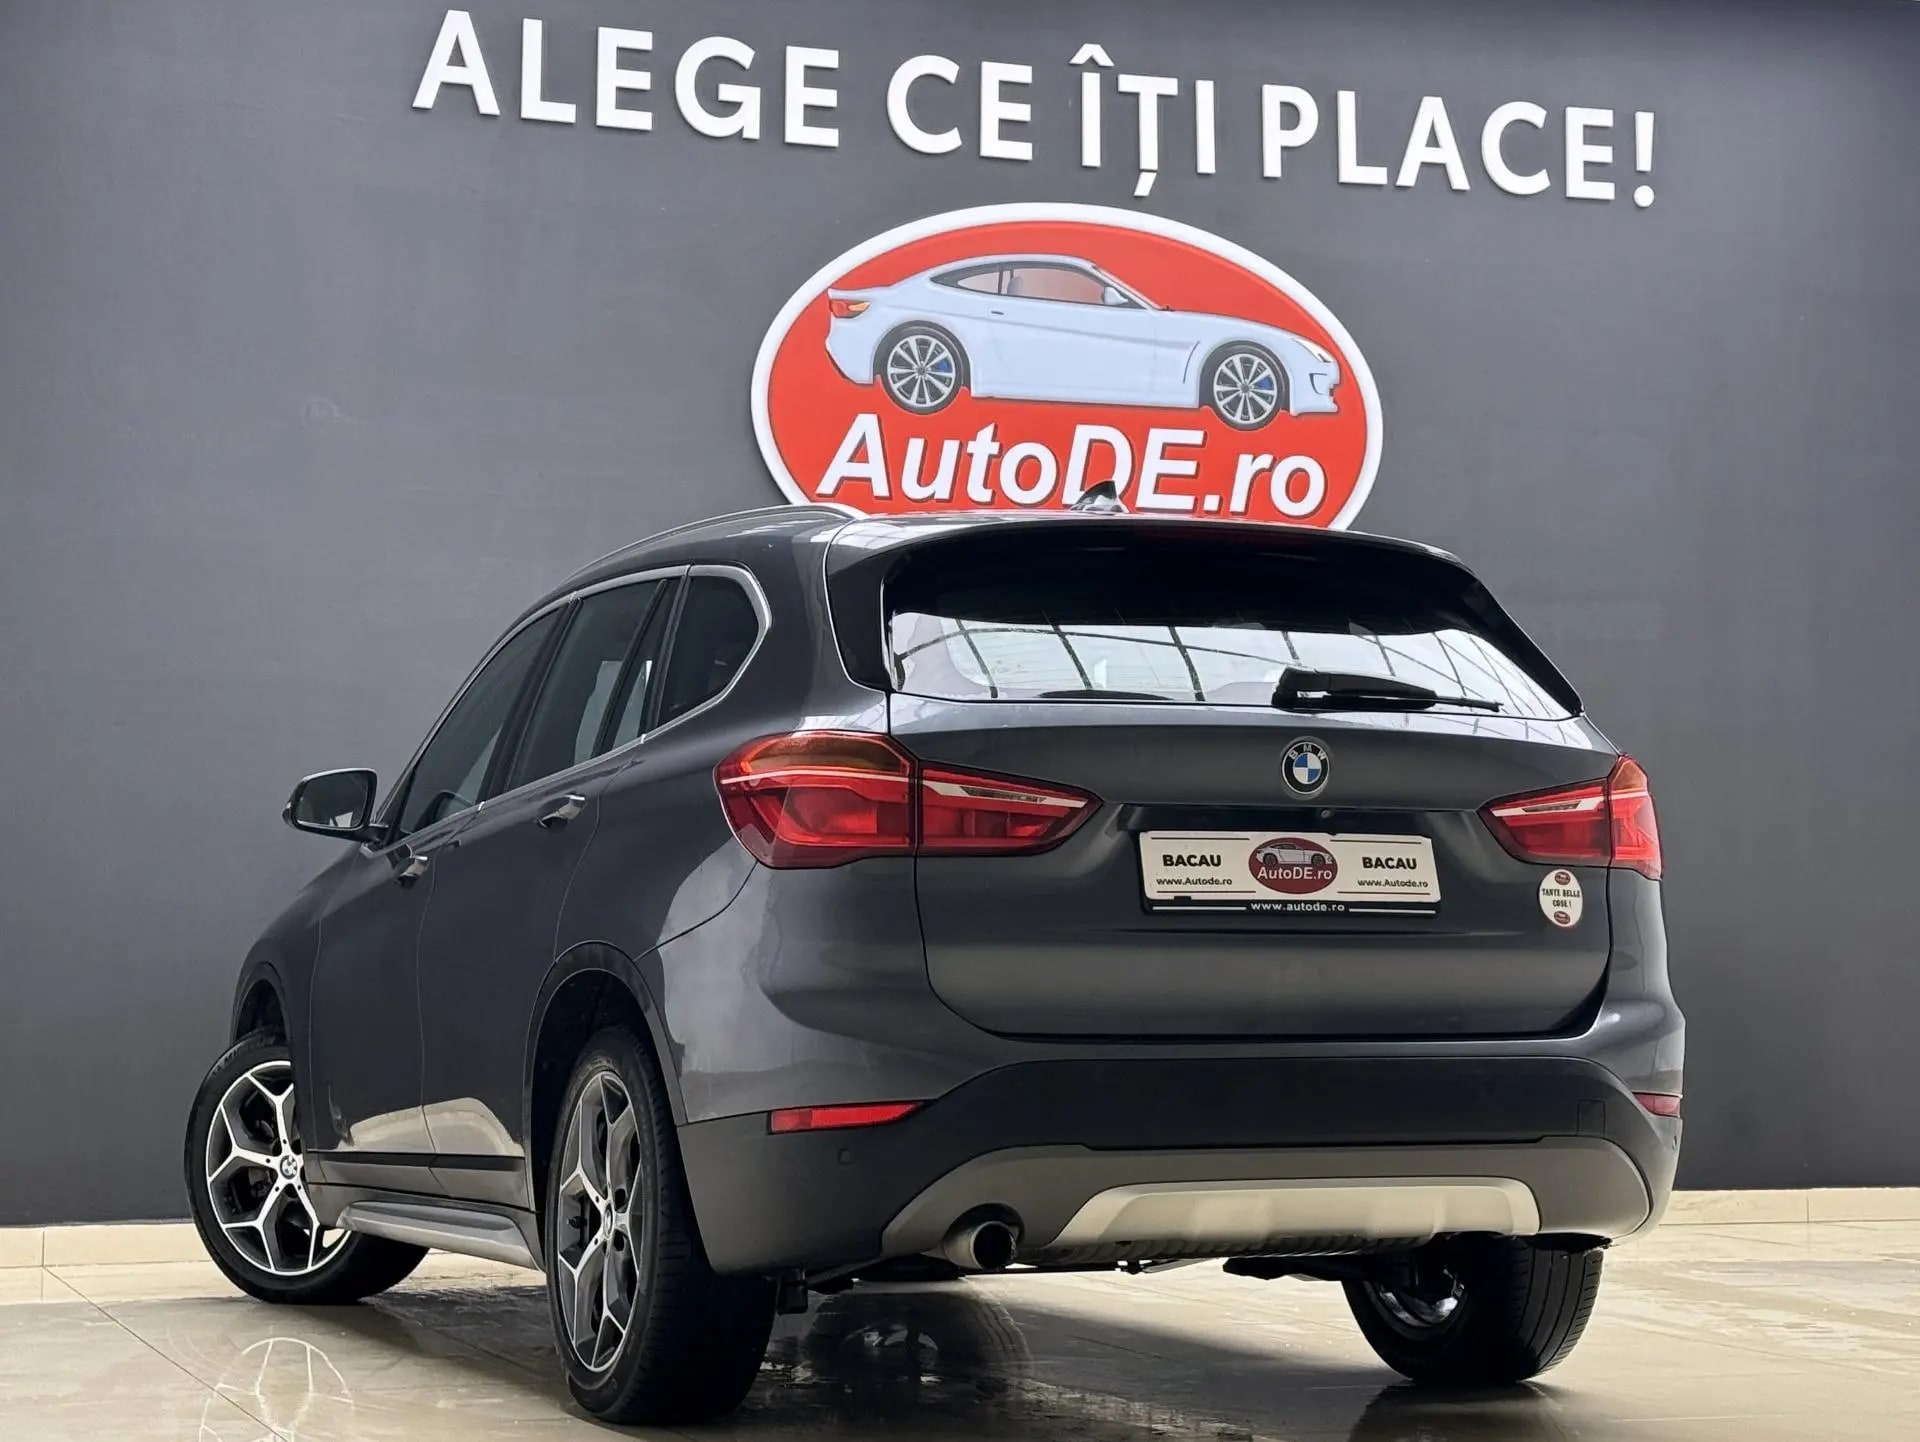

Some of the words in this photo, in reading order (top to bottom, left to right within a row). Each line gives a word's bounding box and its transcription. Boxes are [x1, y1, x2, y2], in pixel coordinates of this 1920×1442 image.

[412, 9, 839, 148] ALEGE
[887, 54, 1033, 161] CE
[1069, 43, 1216, 197] ÎȚI
[1262, 84, 1655, 208] PLACE!
[816, 412, 1327, 518] AutoDE.ro
[1162, 854, 1222, 868] BACAU
[1361, 856, 1417, 870] BACAU
[1257, 866, 1333, 881] AutoDE.ro
[1156, 876, 1233, 886] www.Autode.ro
[1357, 878, 1429, 889] www.Autode.ro
[1250, 902, 1346, 912] www.autode.ro
